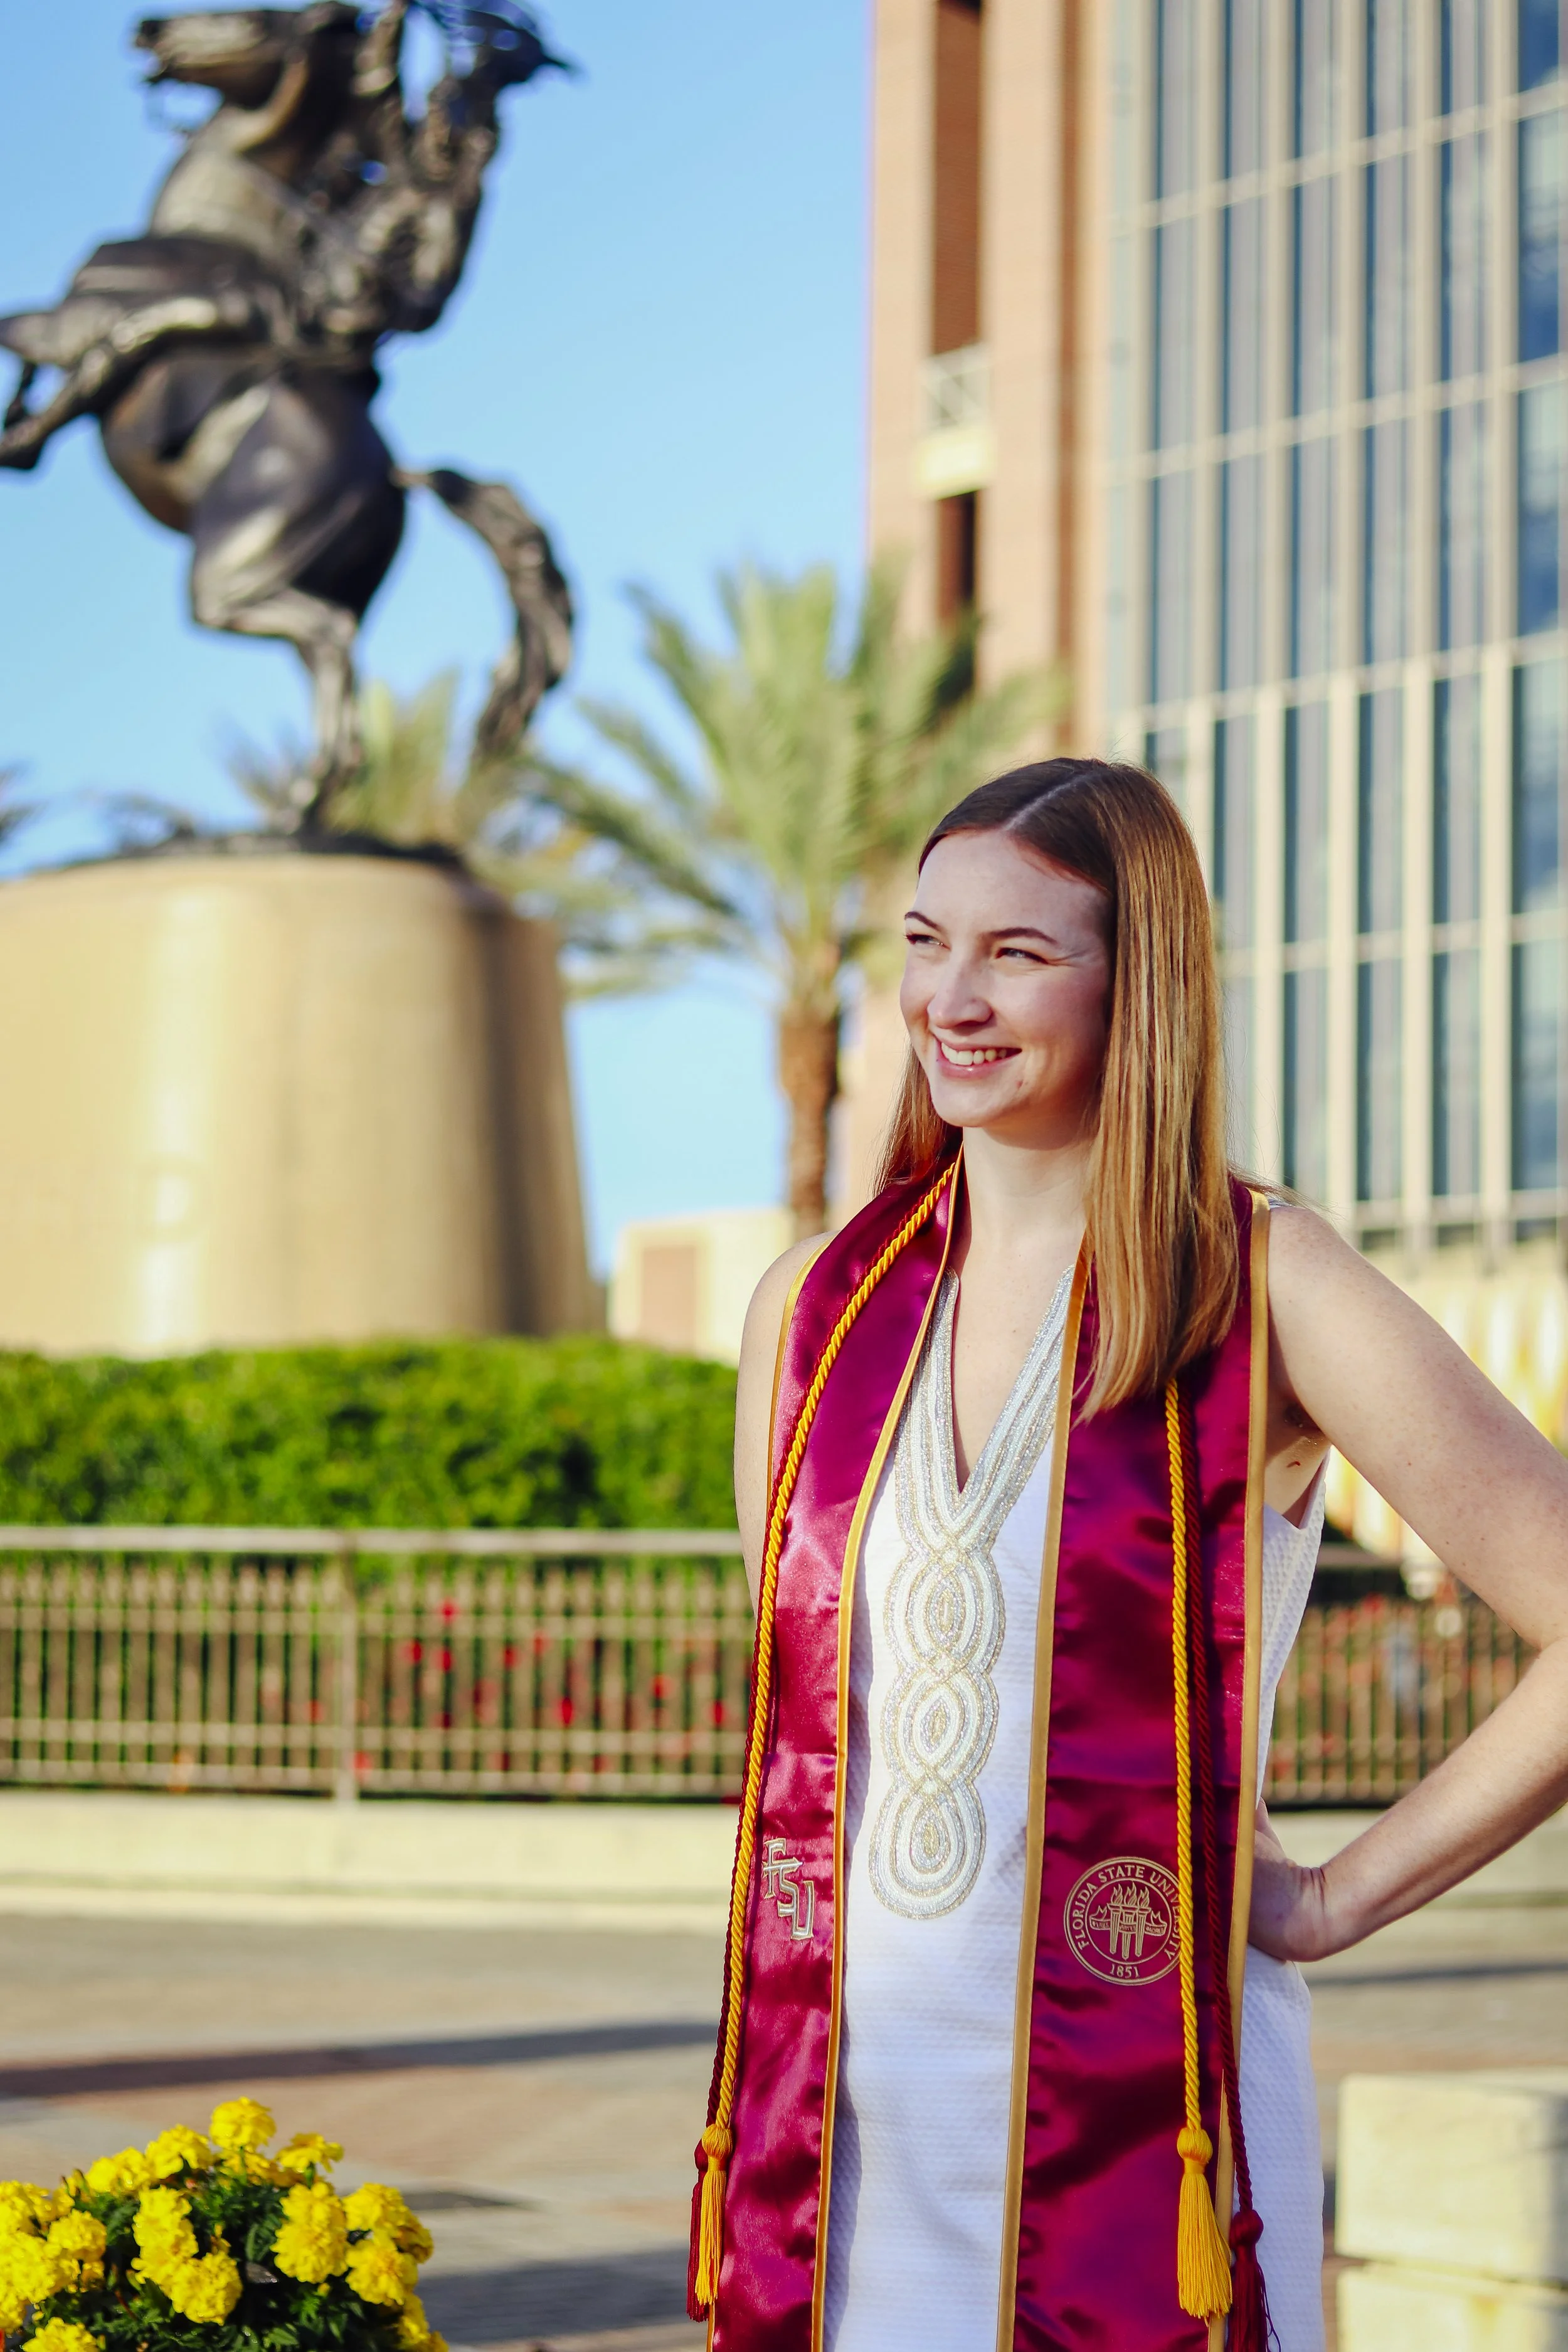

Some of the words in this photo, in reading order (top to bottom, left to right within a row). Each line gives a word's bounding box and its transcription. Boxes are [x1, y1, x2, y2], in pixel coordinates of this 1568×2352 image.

[762, 1838, 815, 1940] FSU
[1073, 1882, 1098, 1951] FLORIDA
[1098, 1865, 1145, 1883] STATE
[1110, 1963, 1140, 1979] 1851
